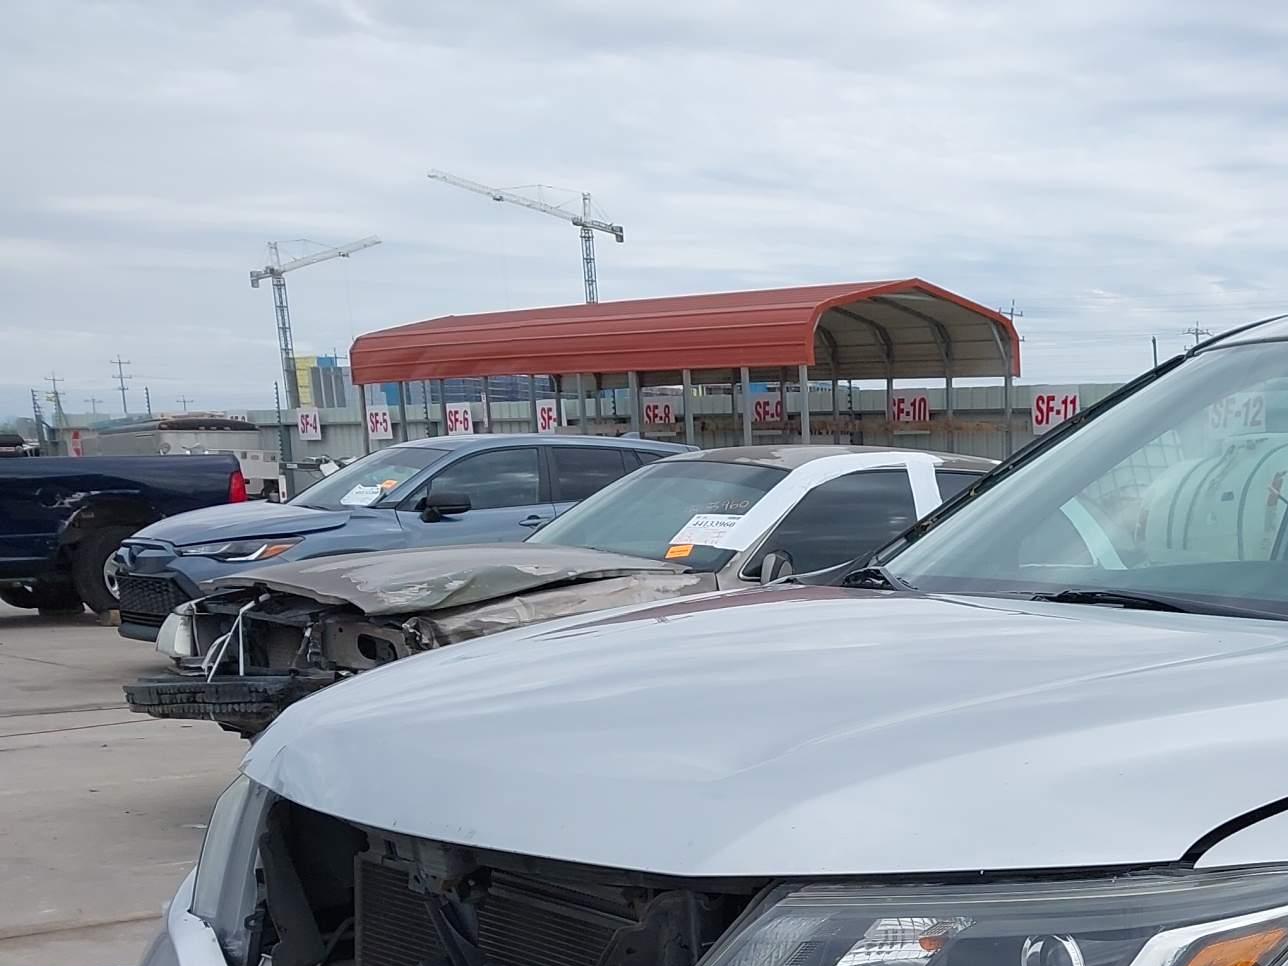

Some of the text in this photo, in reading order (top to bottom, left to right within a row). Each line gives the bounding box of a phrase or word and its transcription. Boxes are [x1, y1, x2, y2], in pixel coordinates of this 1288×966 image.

[448, 410, 469, 431] SF-6
[540, 407, 556, 430] SF-
[645, 404, 671, 424] SF-8
[1035, 395, 1077, 425] SF-11
[1209, 396, 1264, 429] SF-12
[300, 414, 318, 433] SF-4
[369, 412, 388, 432] SF-5
